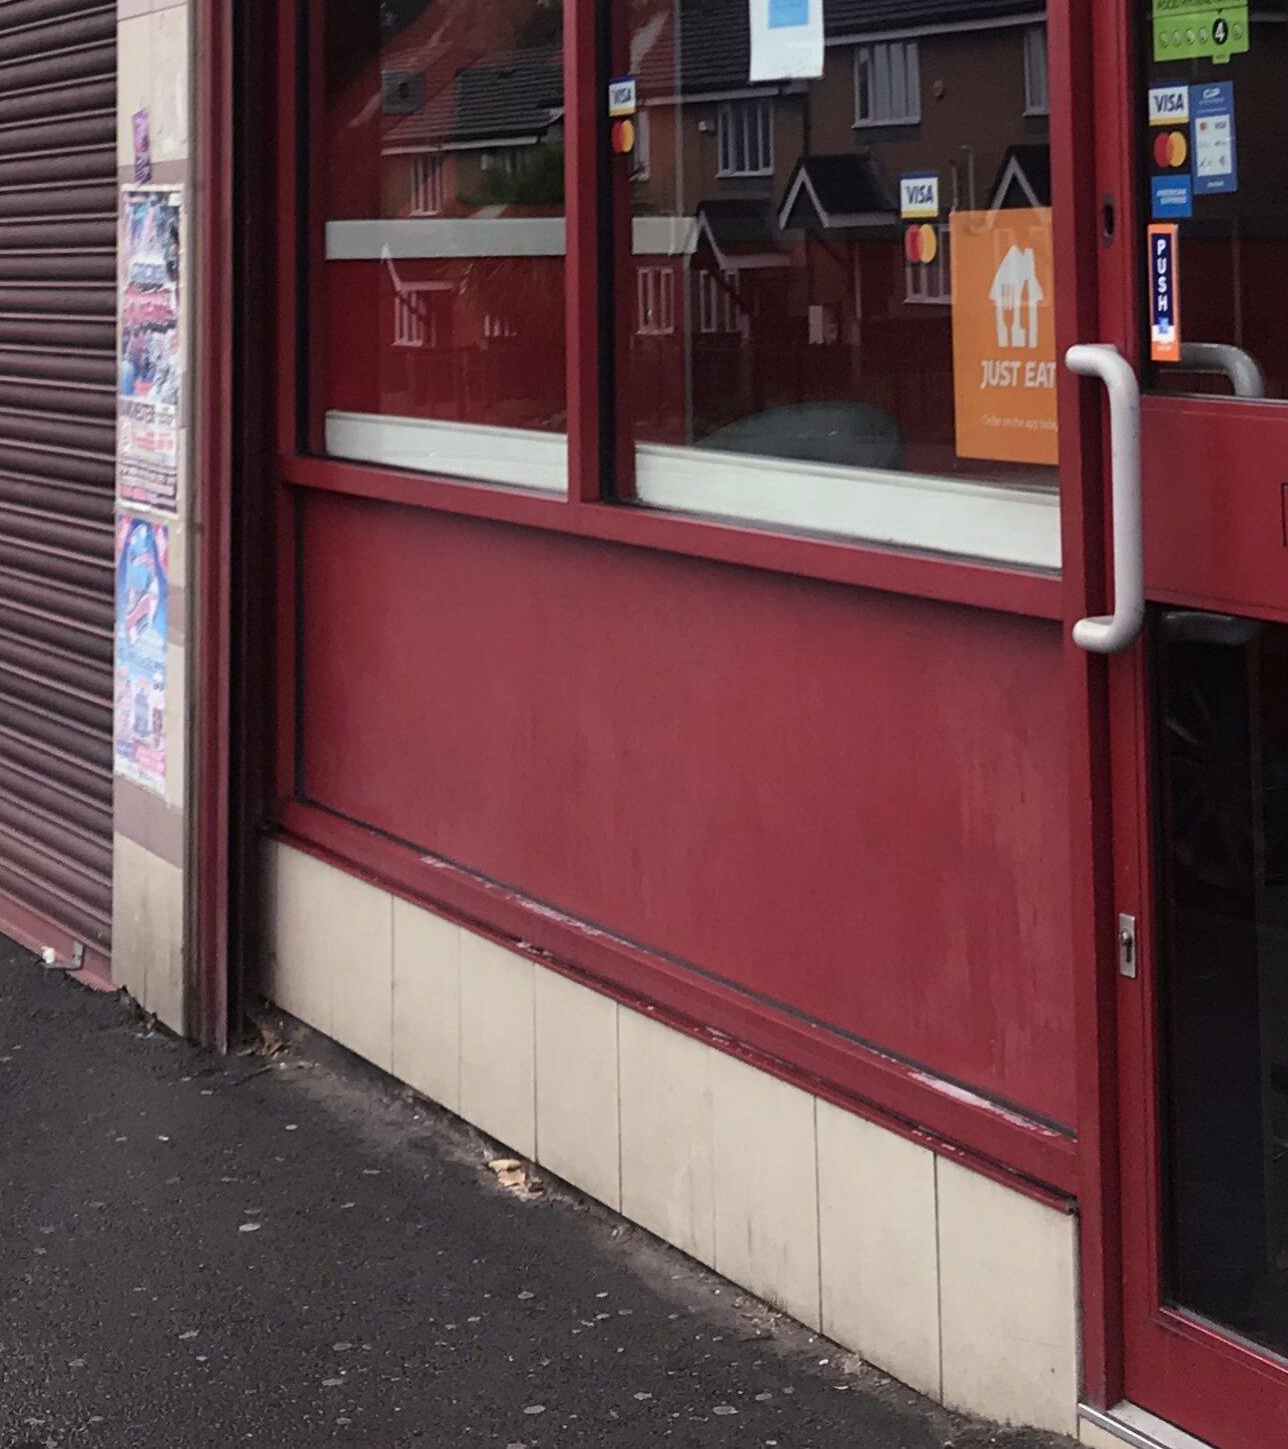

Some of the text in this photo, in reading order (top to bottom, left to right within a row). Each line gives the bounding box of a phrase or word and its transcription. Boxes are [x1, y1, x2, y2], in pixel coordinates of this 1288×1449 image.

[1215, 20, 1226, 42] 4
[1153, 92, 1184, 114] VISA
[904, 184, 933, 206] VISA
[1157, 238, 1168, 312] PUSH
[980, 359, 1057, 389] JUST EAT
